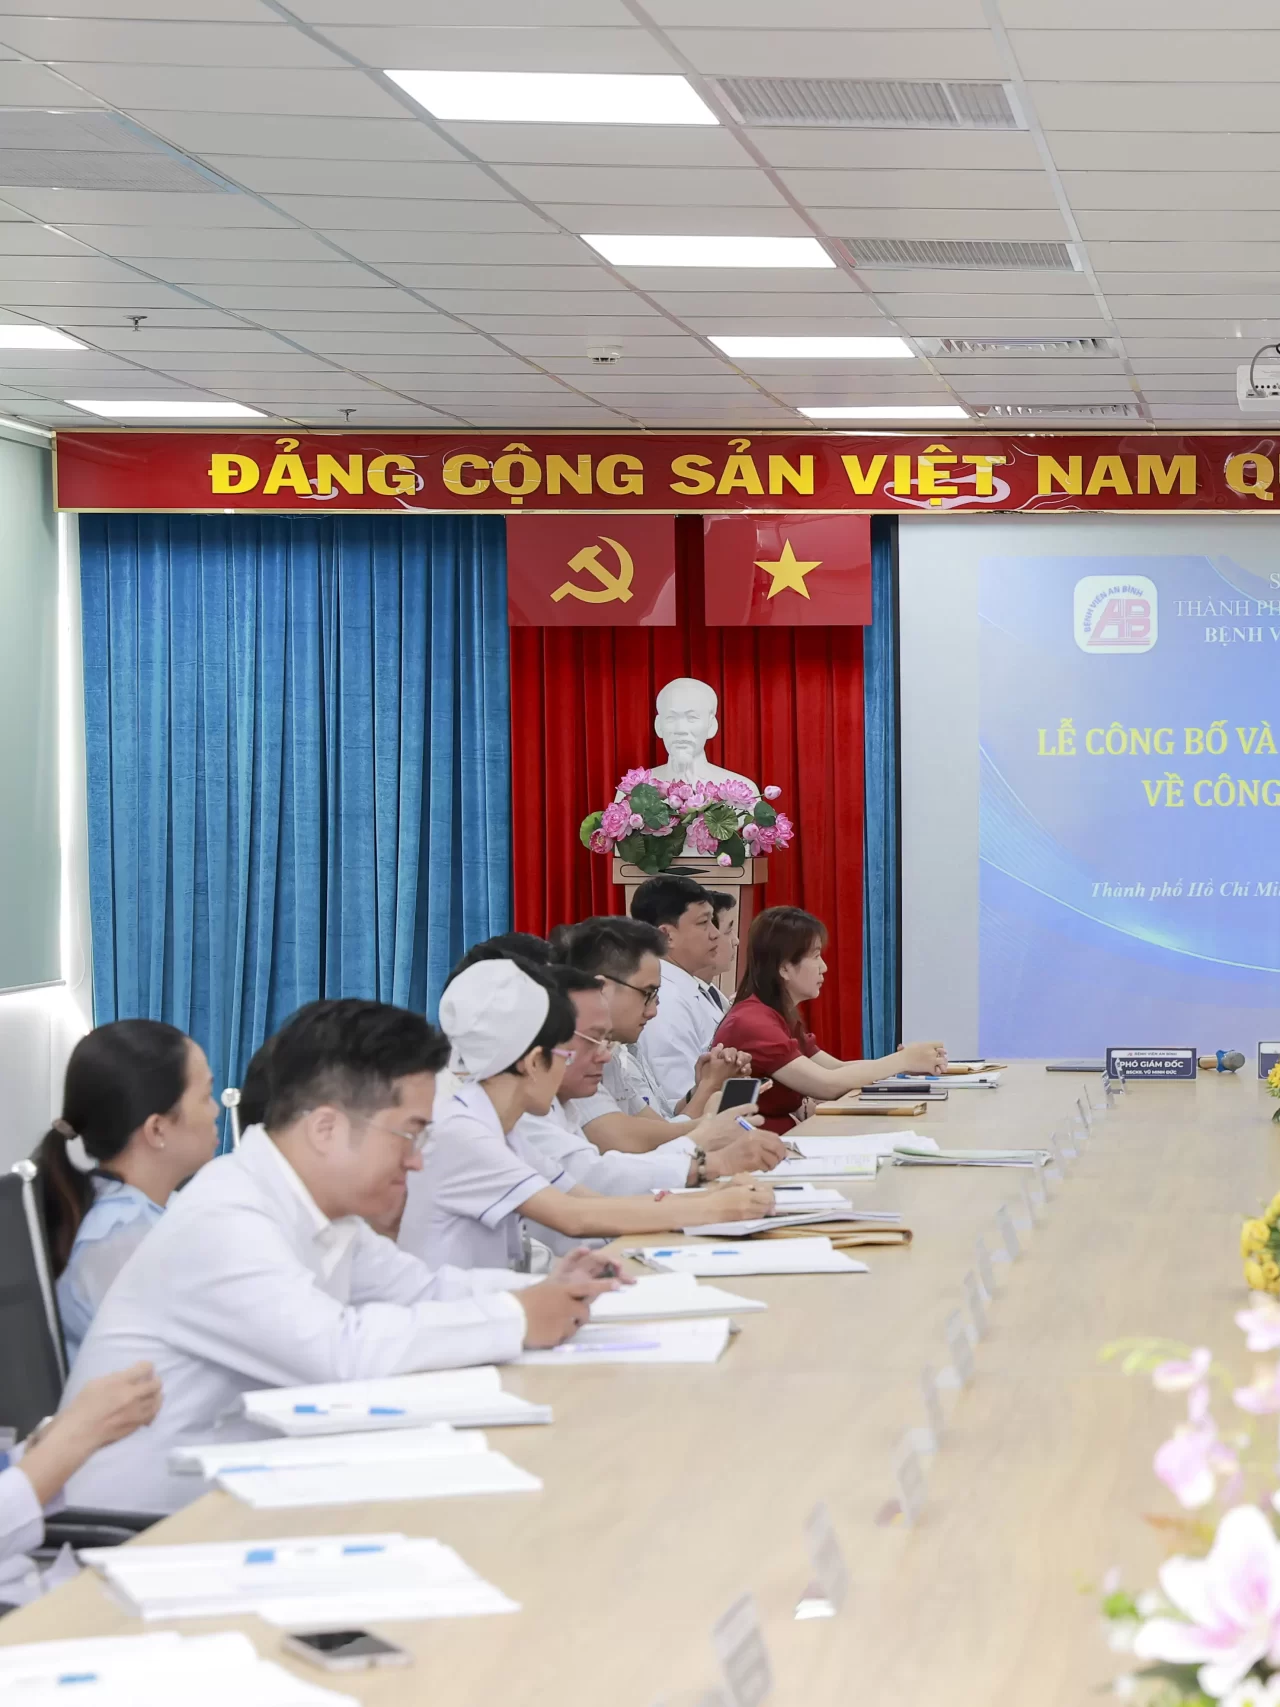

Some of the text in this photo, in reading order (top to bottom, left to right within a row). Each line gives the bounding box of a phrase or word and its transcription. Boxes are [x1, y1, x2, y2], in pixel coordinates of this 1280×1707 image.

[209, 438, 418, 495] ĐẢNG
[442, 443, 644, 504] CỘNG
[670, 438, 815, 495] SẢN
[840, 443, 1007, 506] VIỆT
[1038, 453, 1197, 495] NAM
[1108, 585, 1120, 596] AN
[1174, 596, 1250, 616] THÀNH
[1090, 598, 1151, 639] AB
[1204, 624, 1263, 646] BỆNH
[1037, 717, 1077, 756] LỄ
[1085, 721, 1175, 756] CÔNG
[1184, 720, 1228, 755] BỐ
[1235, 720, 1279, 754] VÀ
[1141, 771, 1184, 807] VỀ
[1091, 881, 1146, 898] Thành
[1149, 877, 1183, 901] phố
[1187, 877, 1214, 897] Hồ
[1219, 881, 1250, 897] Chí
[1120, 1059, 1184, 1068] PHÓ GIÁM ĐỐC
